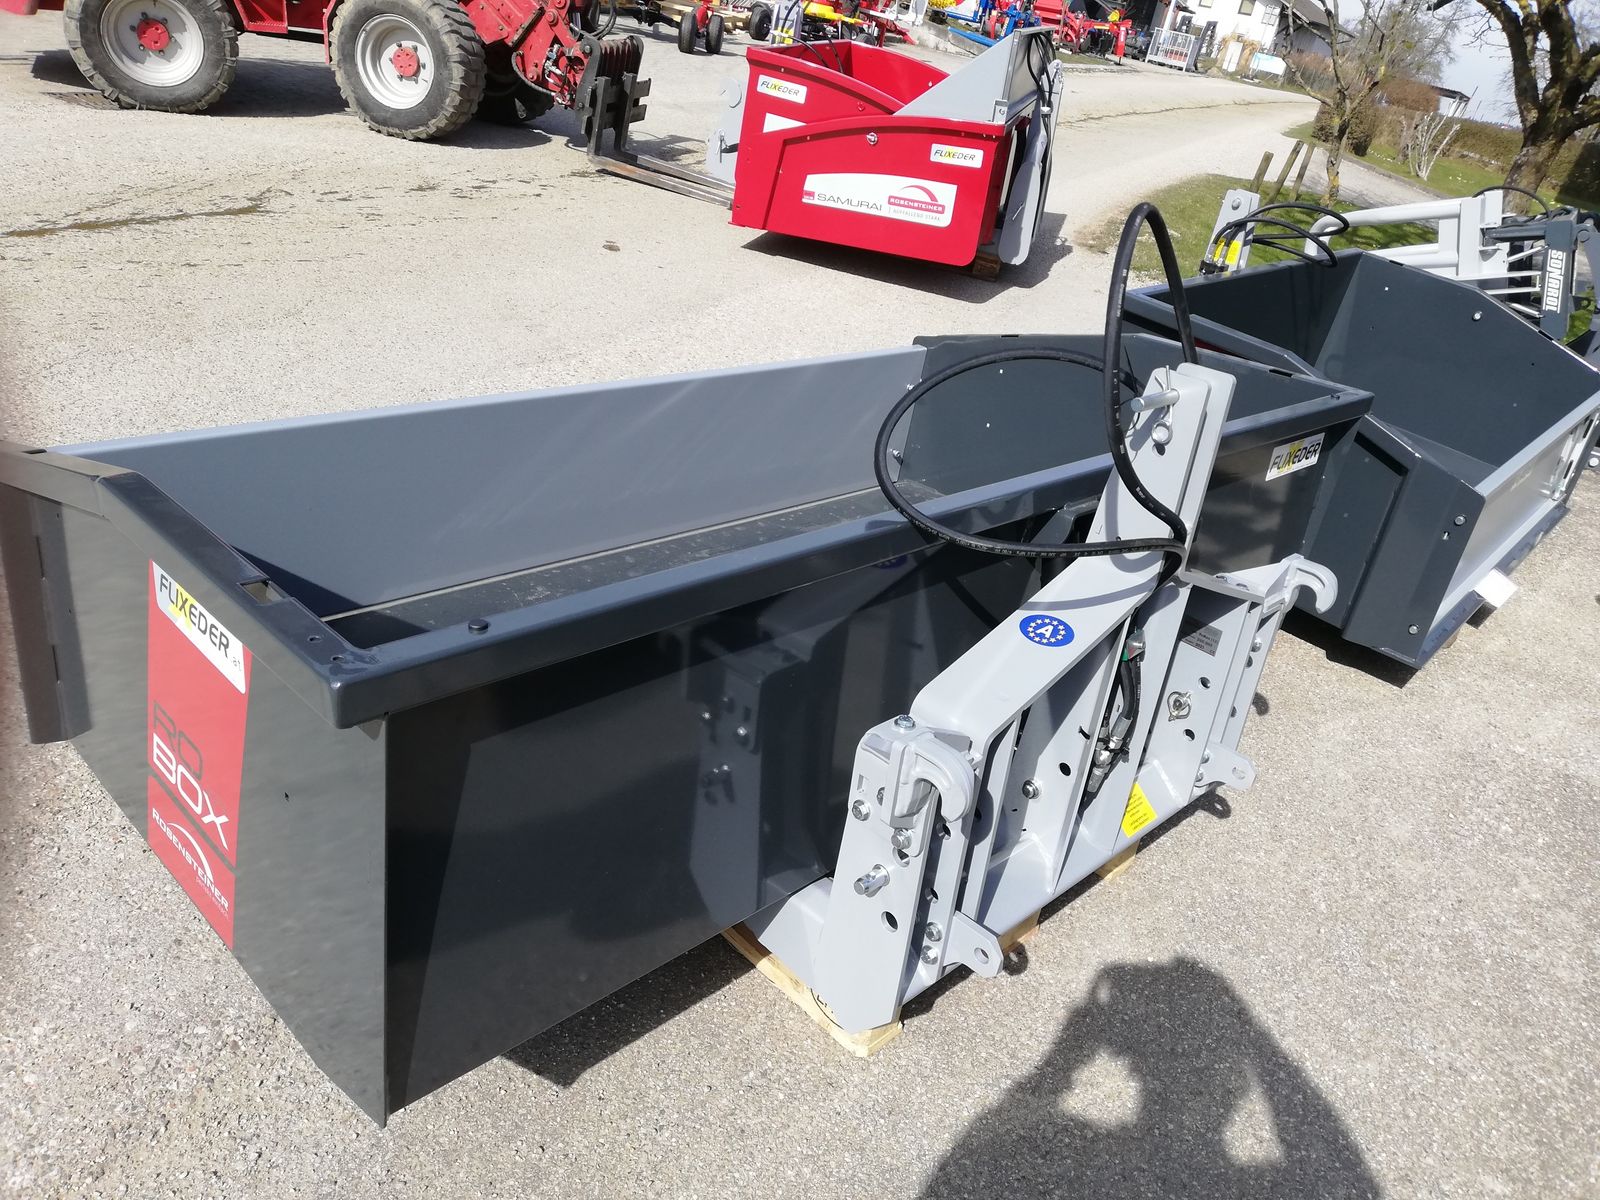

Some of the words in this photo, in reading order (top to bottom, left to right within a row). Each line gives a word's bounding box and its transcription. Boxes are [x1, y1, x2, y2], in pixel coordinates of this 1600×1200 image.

[760, 80, 800, 97] FLIXEDER
[933, 149, 976, 161] FLIXEDER
[817, 193, 882, 211] SAMURAI
[1543, 249, 1566, 314] SONAROL
[1269, 442, 1321, 473] FLIXEDER
[159, 573, 230, 658] FLIXEDER
[1035, 624, 1054, 639] A
[153, 700, 203, 781] RO
[153, 732, 229, 851] BOX
[152, 807, 229, 911] ROSENSTEINER
